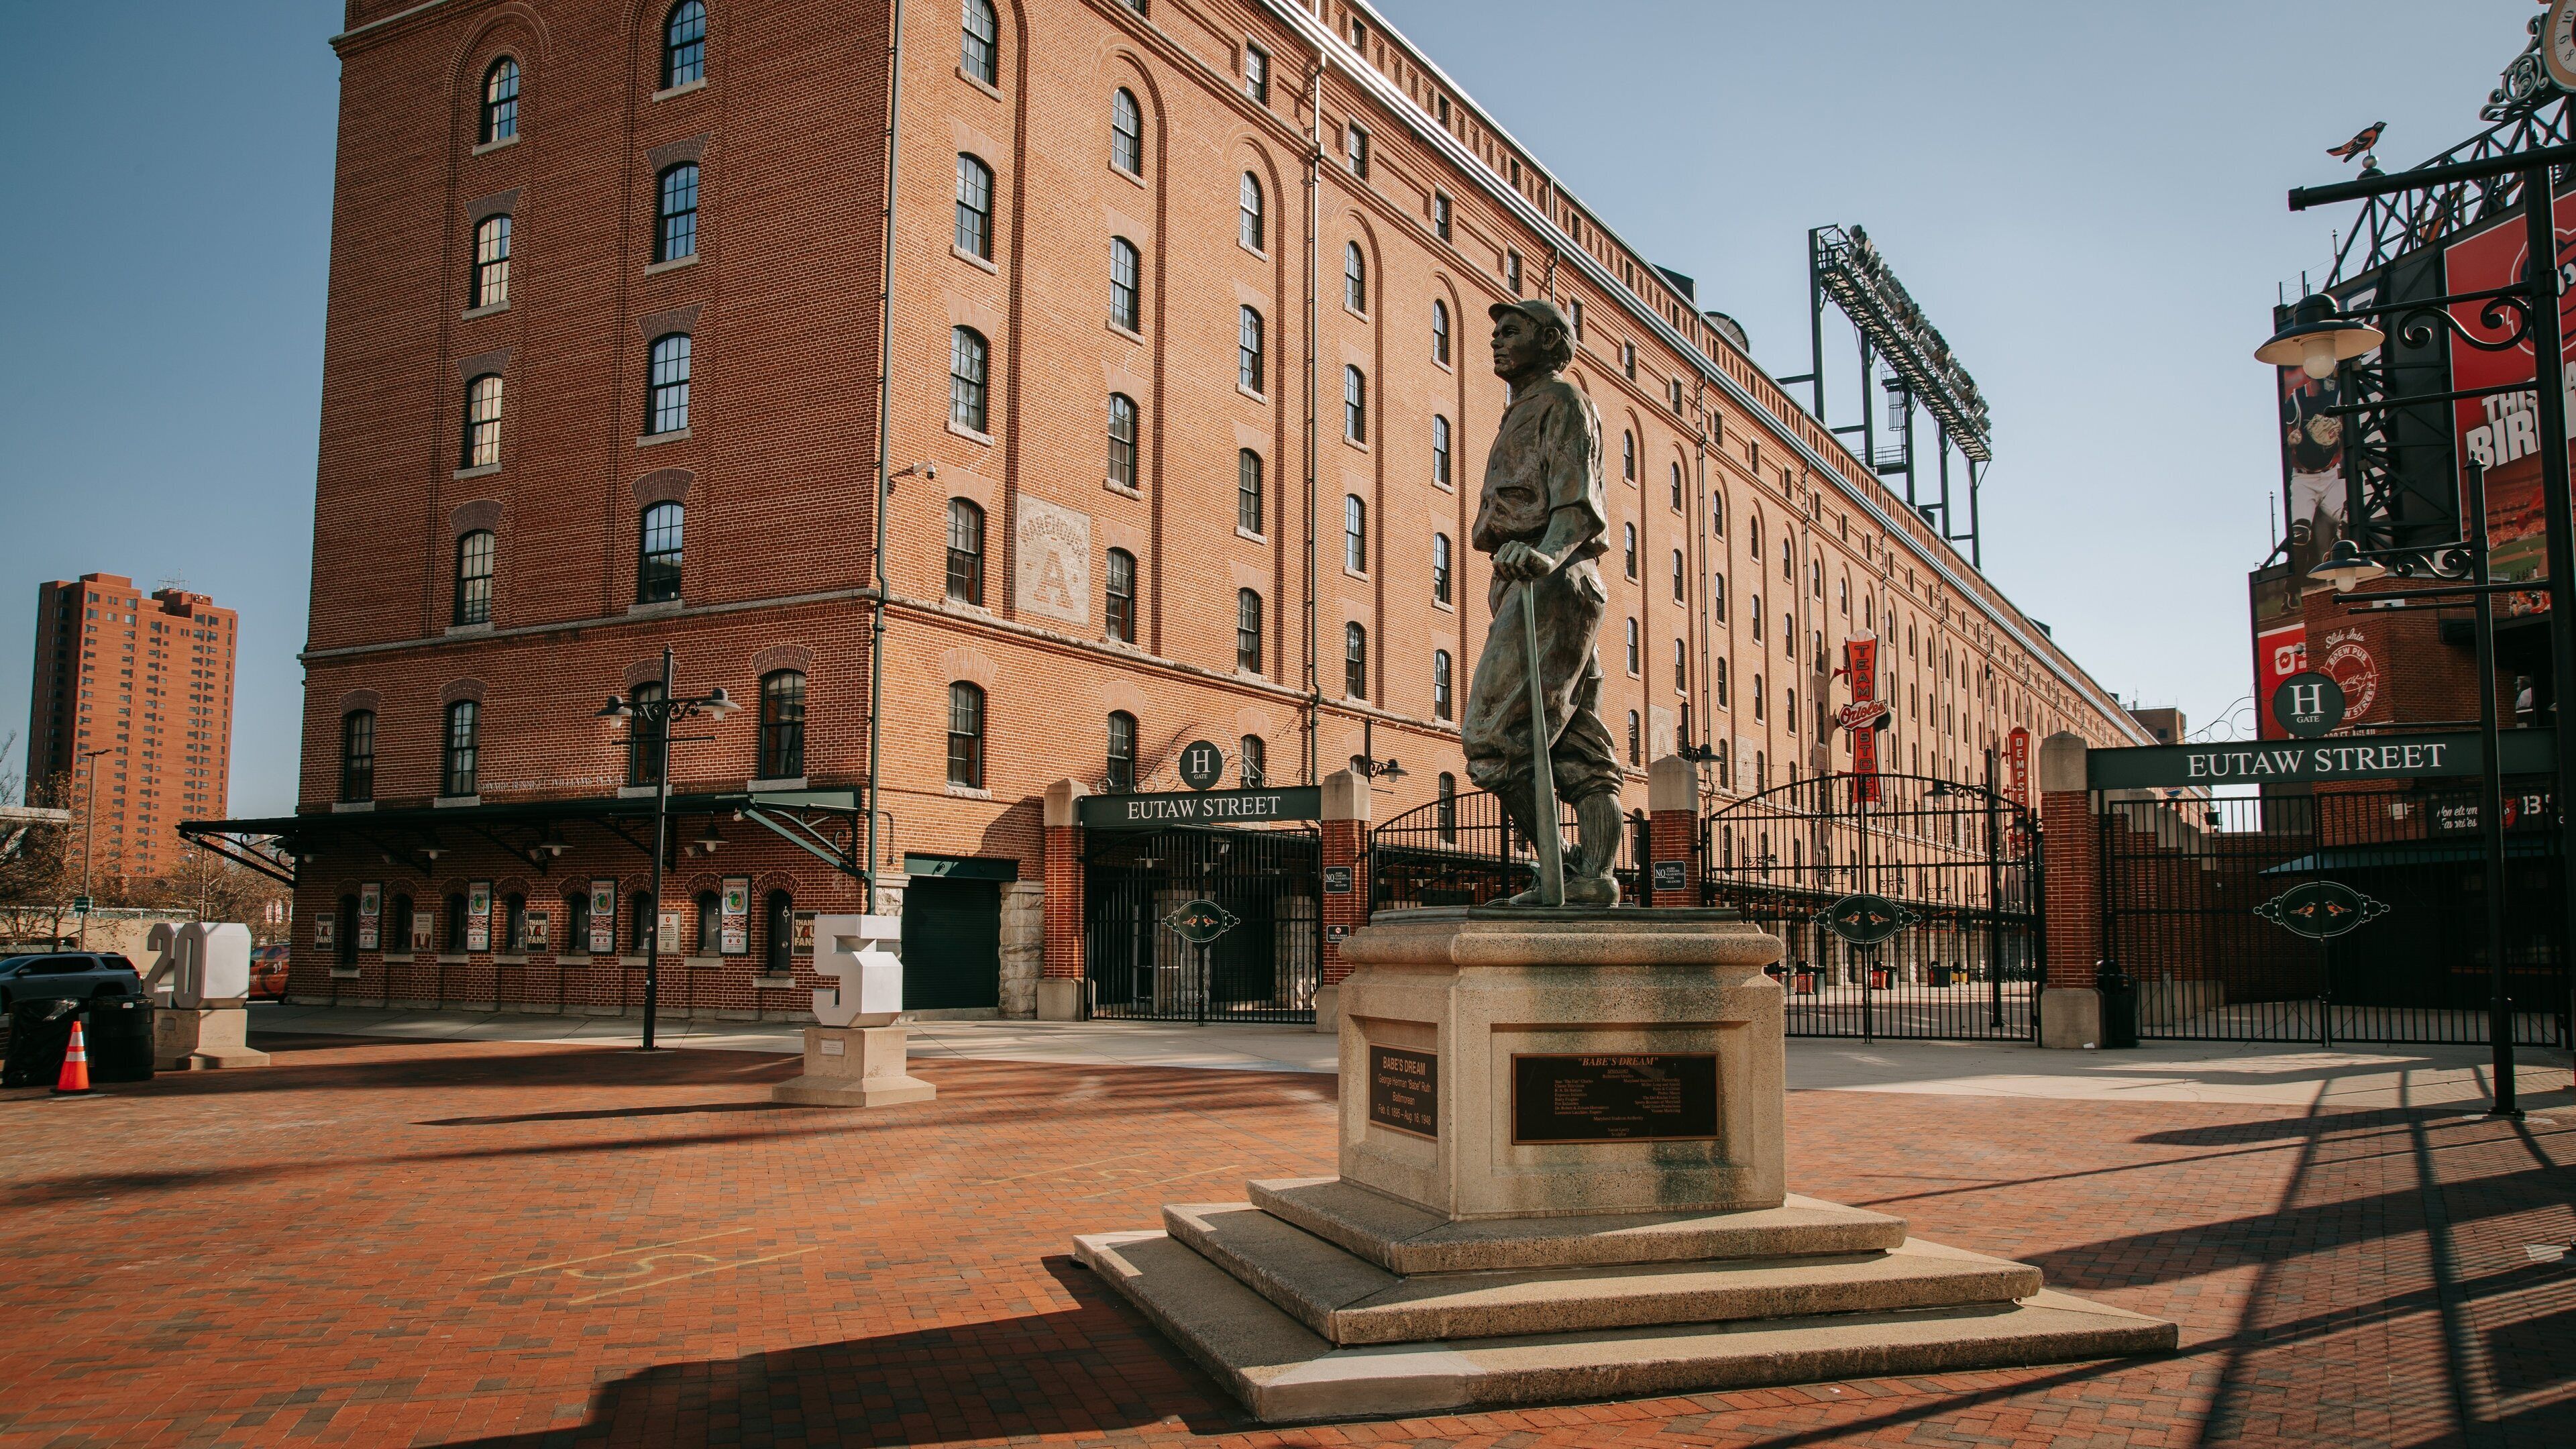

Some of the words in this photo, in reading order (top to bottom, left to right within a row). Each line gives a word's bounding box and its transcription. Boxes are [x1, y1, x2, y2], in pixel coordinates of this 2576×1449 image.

[2565, 49, 2575, 61] 8
[1034, 550, 1073, 609] A
[2325, 629, 2345, 649] Slide
[2347, 628, 2365, 642] Into
[2329, 647, 2350, 665] BREW
[2352, 647, 2367, 661] PUB
[1854, 645, 1870, 697] TEAM
[2289, 684, 2325, 715] H
[1840, 700, 1886, 725] Orioles
[1191, 749, 1211, 773] H
[2186, 750, 2304, 777] EUTAW
[2314, 743, 2446, 772] STREET
[596, 774, 623, 785] PLAZA
[1128, 799, 1197, 819] EUTAW
[1203, 796, 1281, 816] STREET
[1326, 873, 1335, 881] NO
[1655, 869, 1666, 877] NO
[528, 936, 547, 944] FANS
[144, 922, 225, 1009] 20
[812, 914, 880, 1028] 5
[1383, 1056, 1403, 1072] BABE'S
[1405, 1059, 1426, 1076] DREAM
[1578, 1057, 1616, 1066] "BABE'S
[1619, 1057, 1658, 1066] DREAM"
[1378, 1073, 1393, 1087] George
[1392, 1076, 1407, 1088] Herman
[1421, 1081, 1432, 1093] Ruth
[1393, 1091, 1415, 1106] Baltimorean
[1378, 1104, 1387, 1114] Feb.
[1391, 1107, 1401, 1118] 1895
[1404, 1110, 1412, 1124] Aug.
[1421, 1114, 1432, 1126] 1948
